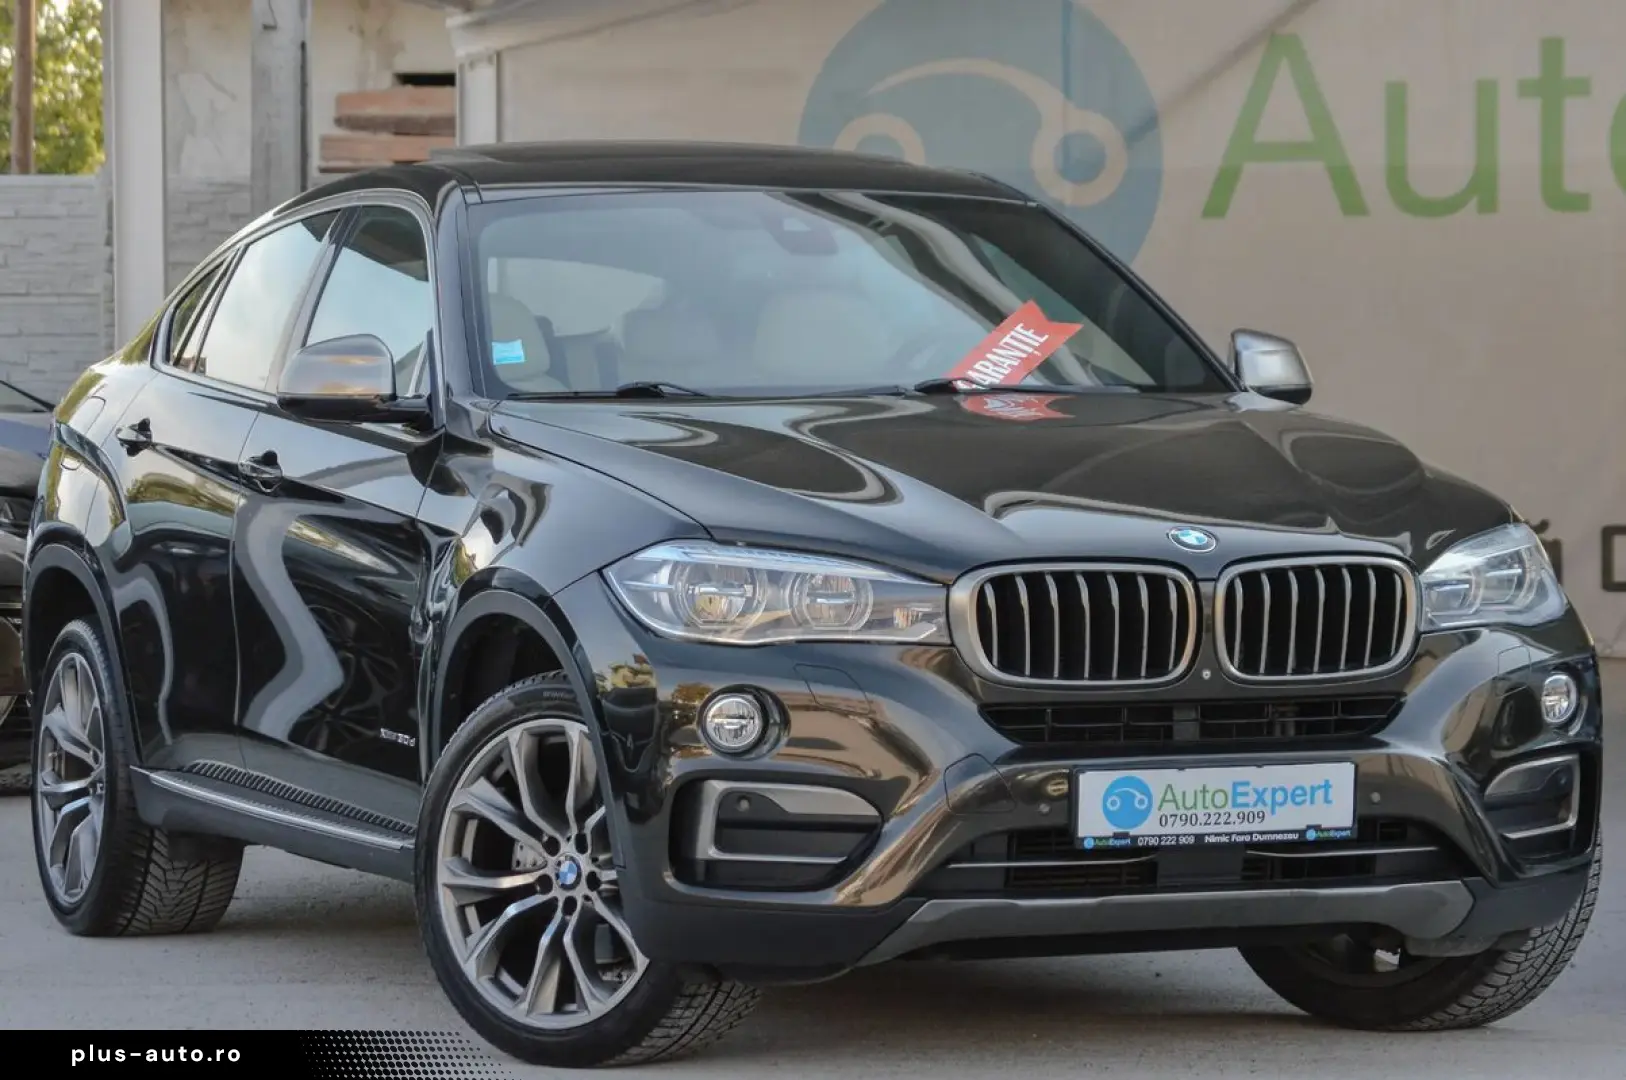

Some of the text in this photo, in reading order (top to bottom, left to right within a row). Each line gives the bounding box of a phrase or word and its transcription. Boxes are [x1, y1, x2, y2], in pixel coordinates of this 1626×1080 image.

[1202, 33, 1626, 219] Aut
[1157, 778, 1333, 815] AutoExpert
[1159, 811, 1266, 827] 0790.222.909
[1137, 835, 1159, 846] 0790
[1161, 835, 1177, 845] 222
